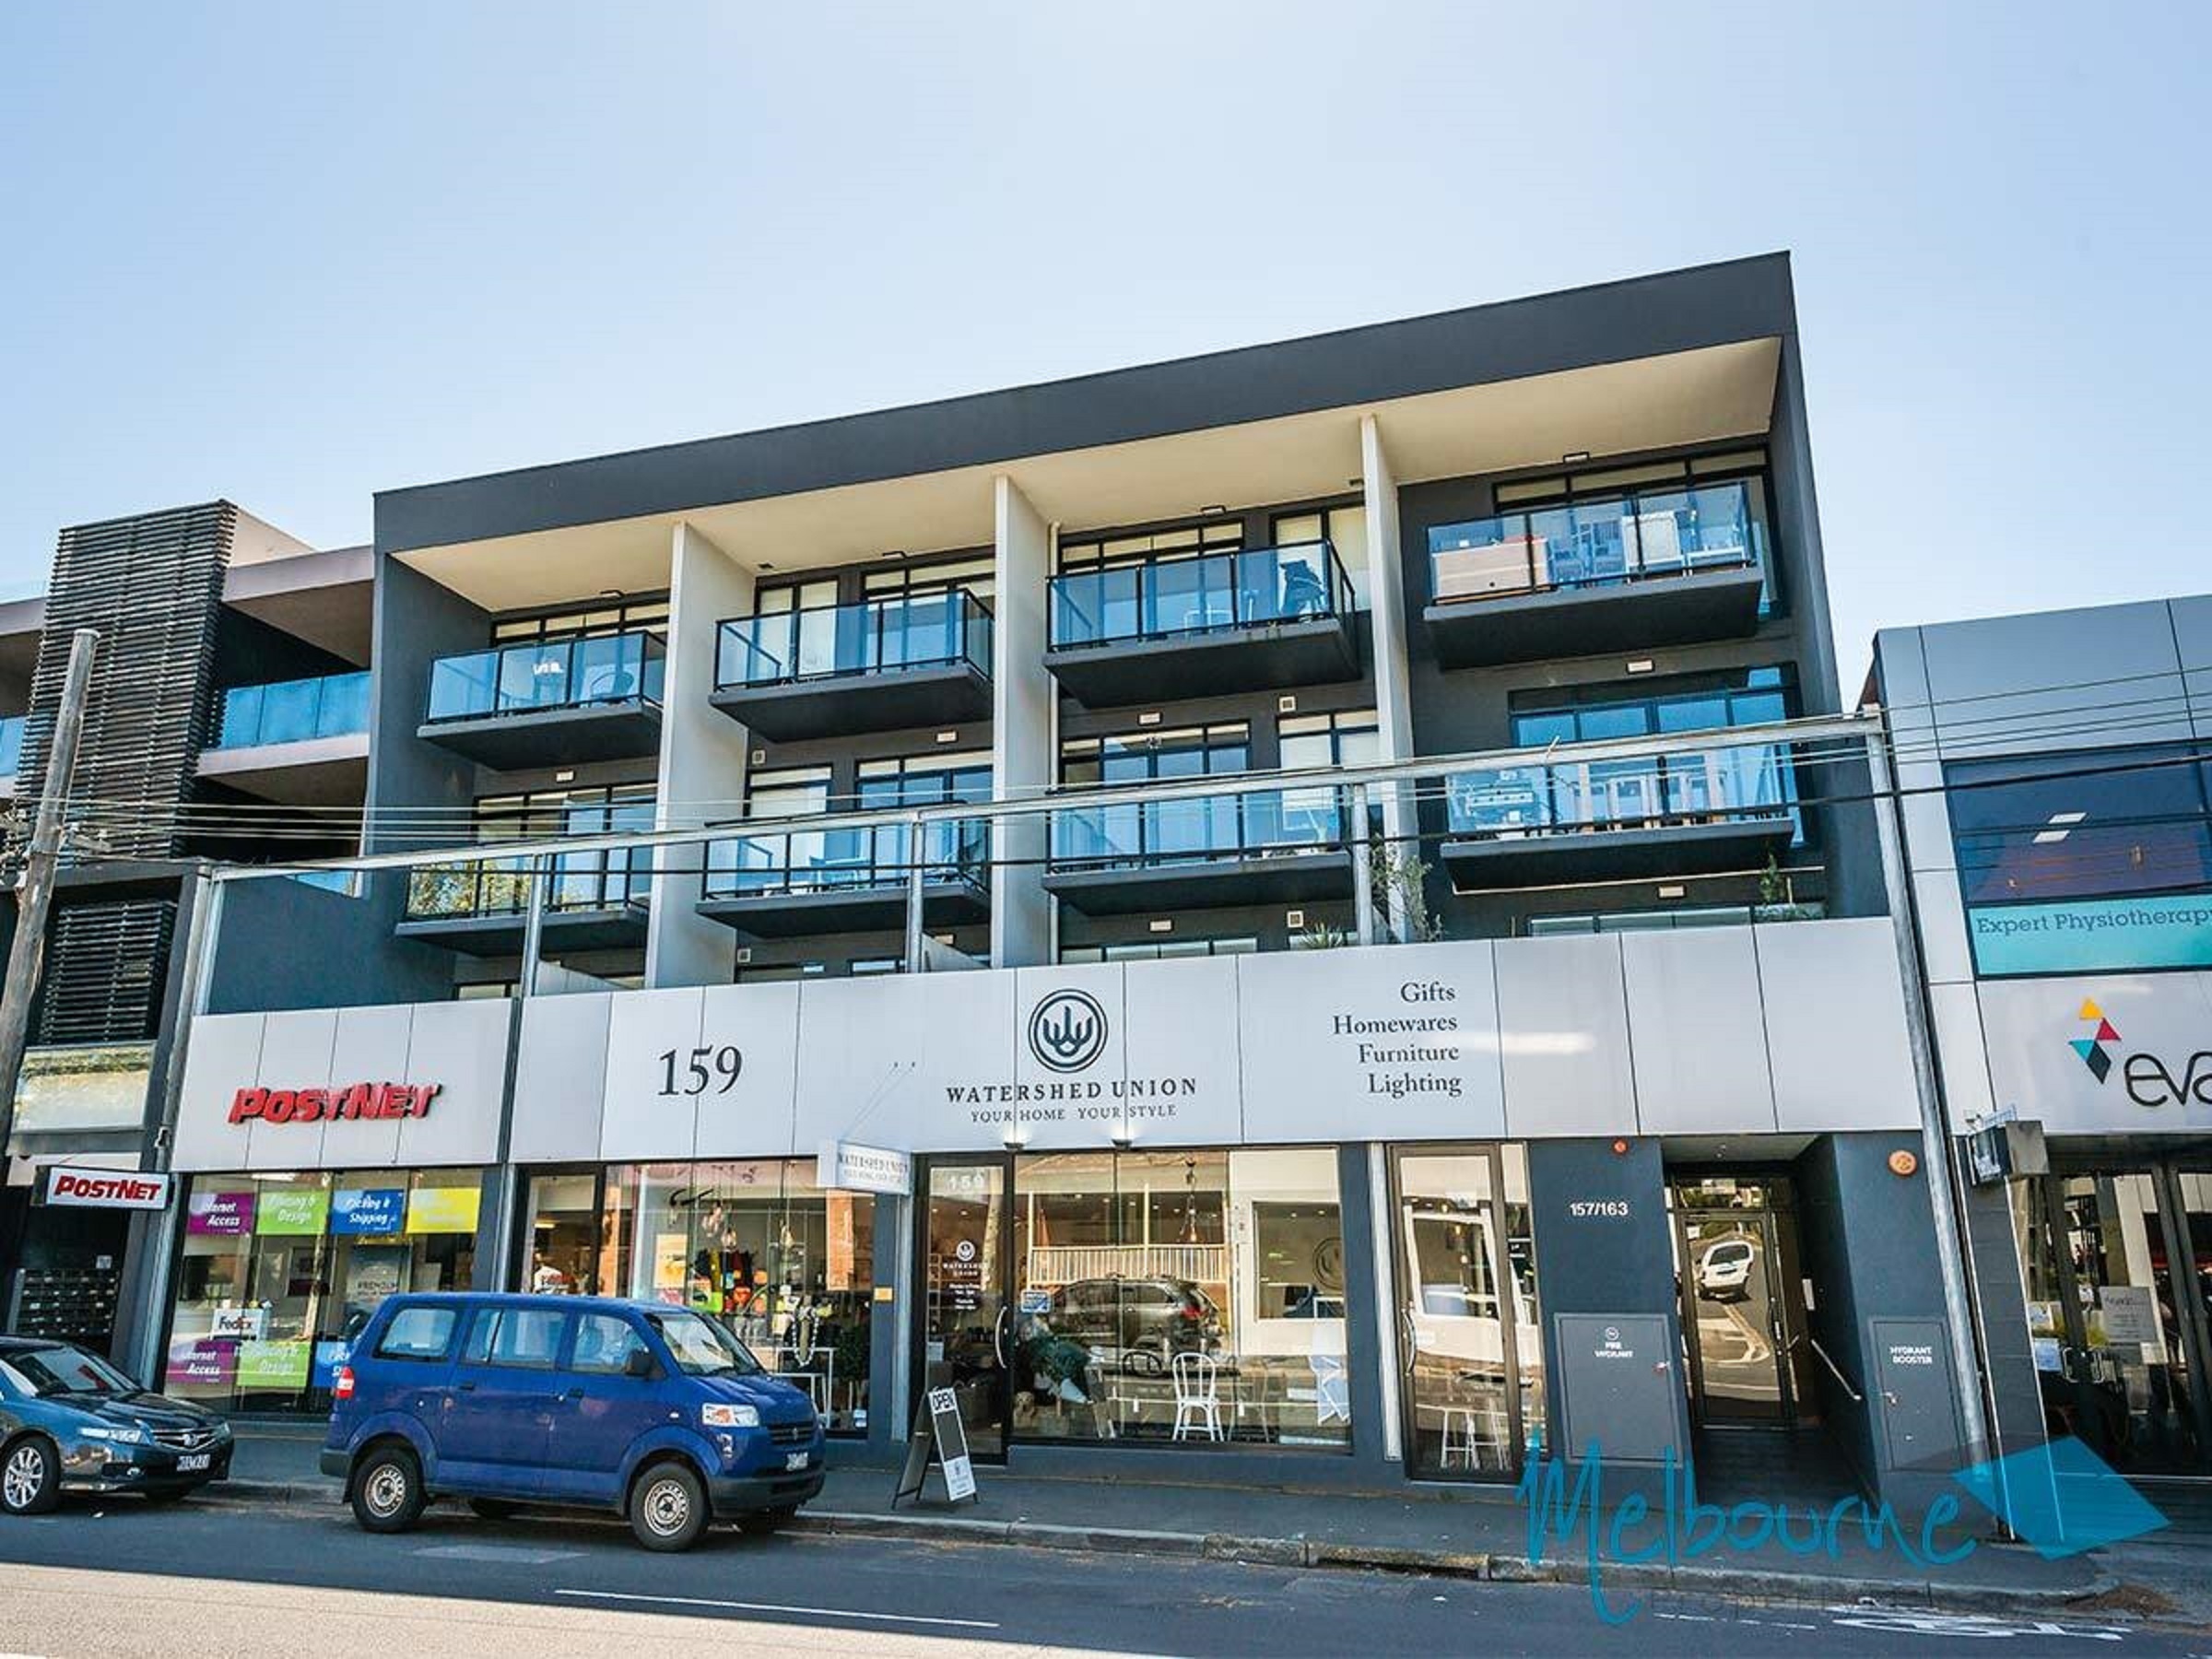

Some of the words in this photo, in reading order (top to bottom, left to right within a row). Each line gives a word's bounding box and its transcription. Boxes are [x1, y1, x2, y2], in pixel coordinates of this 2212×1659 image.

[1976, 915, 2050, 935] Expert
[2053, 905, 2212, 931] Physiotherap
[1400, 981, 1456, 1003] Gifts
[1333, 1015, 1458, 1034] Homewares
[1359, 1042, 1459, 1063] Furniture
[658, 1044, 742, 1095] 159
[947, 1082, 1102, 1103] WATERSHED
[1112, 1077, 1197, 1098] UNION
[1369, 1072, 1463, 1099] Lighting
[971, 1110, 1013, 1123] YOUR
[1019, 1108, 1065, 1121] HOME
[1077, 1107, 1122, 1120] YOUR
[1129, 1105, 1177, 1118] STYLE
[1570, 1202, 1629, 1216] 157/163
